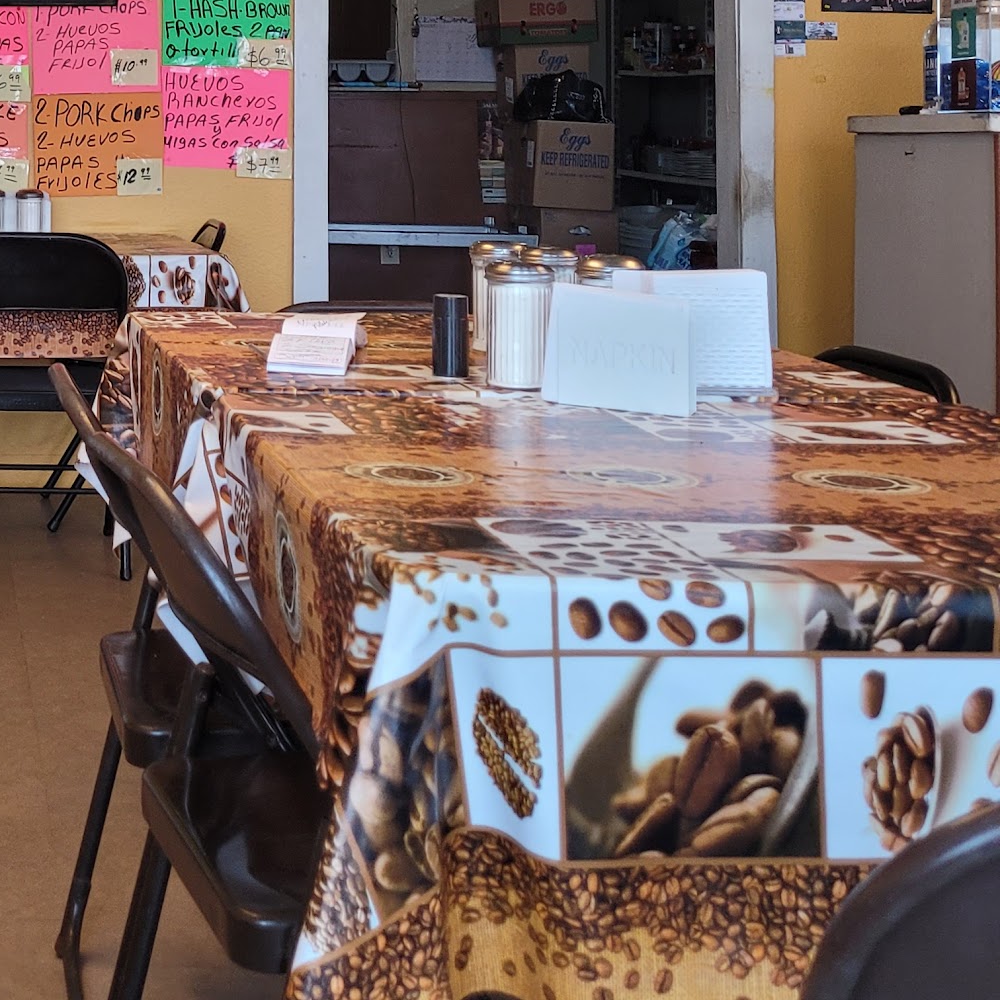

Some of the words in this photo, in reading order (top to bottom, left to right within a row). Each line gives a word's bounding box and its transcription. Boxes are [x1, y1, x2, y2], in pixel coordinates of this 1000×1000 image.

[56, 23, 120, 38] HUEVOS
[53, 39, 109, 57] PAPAS
[48, 54, 106, 73] FRIJOL
[538, 50, 569, 67] Eggs
[165, 73, 244, 91] HUEVOS
[167, 92, 277, 110] RANCheros
[55, 99, 107, 127] PORK
[165, 113, 220, 128] PAPAS
[60, 130, 136, 149] HUEVOS
[559, 128, 591, 146] Eggs
[38, 157, 100, 173] PAPAS
[541, 152, 558, 166] KEEP
[559, 152, 609, 169] REFRIGERATED
